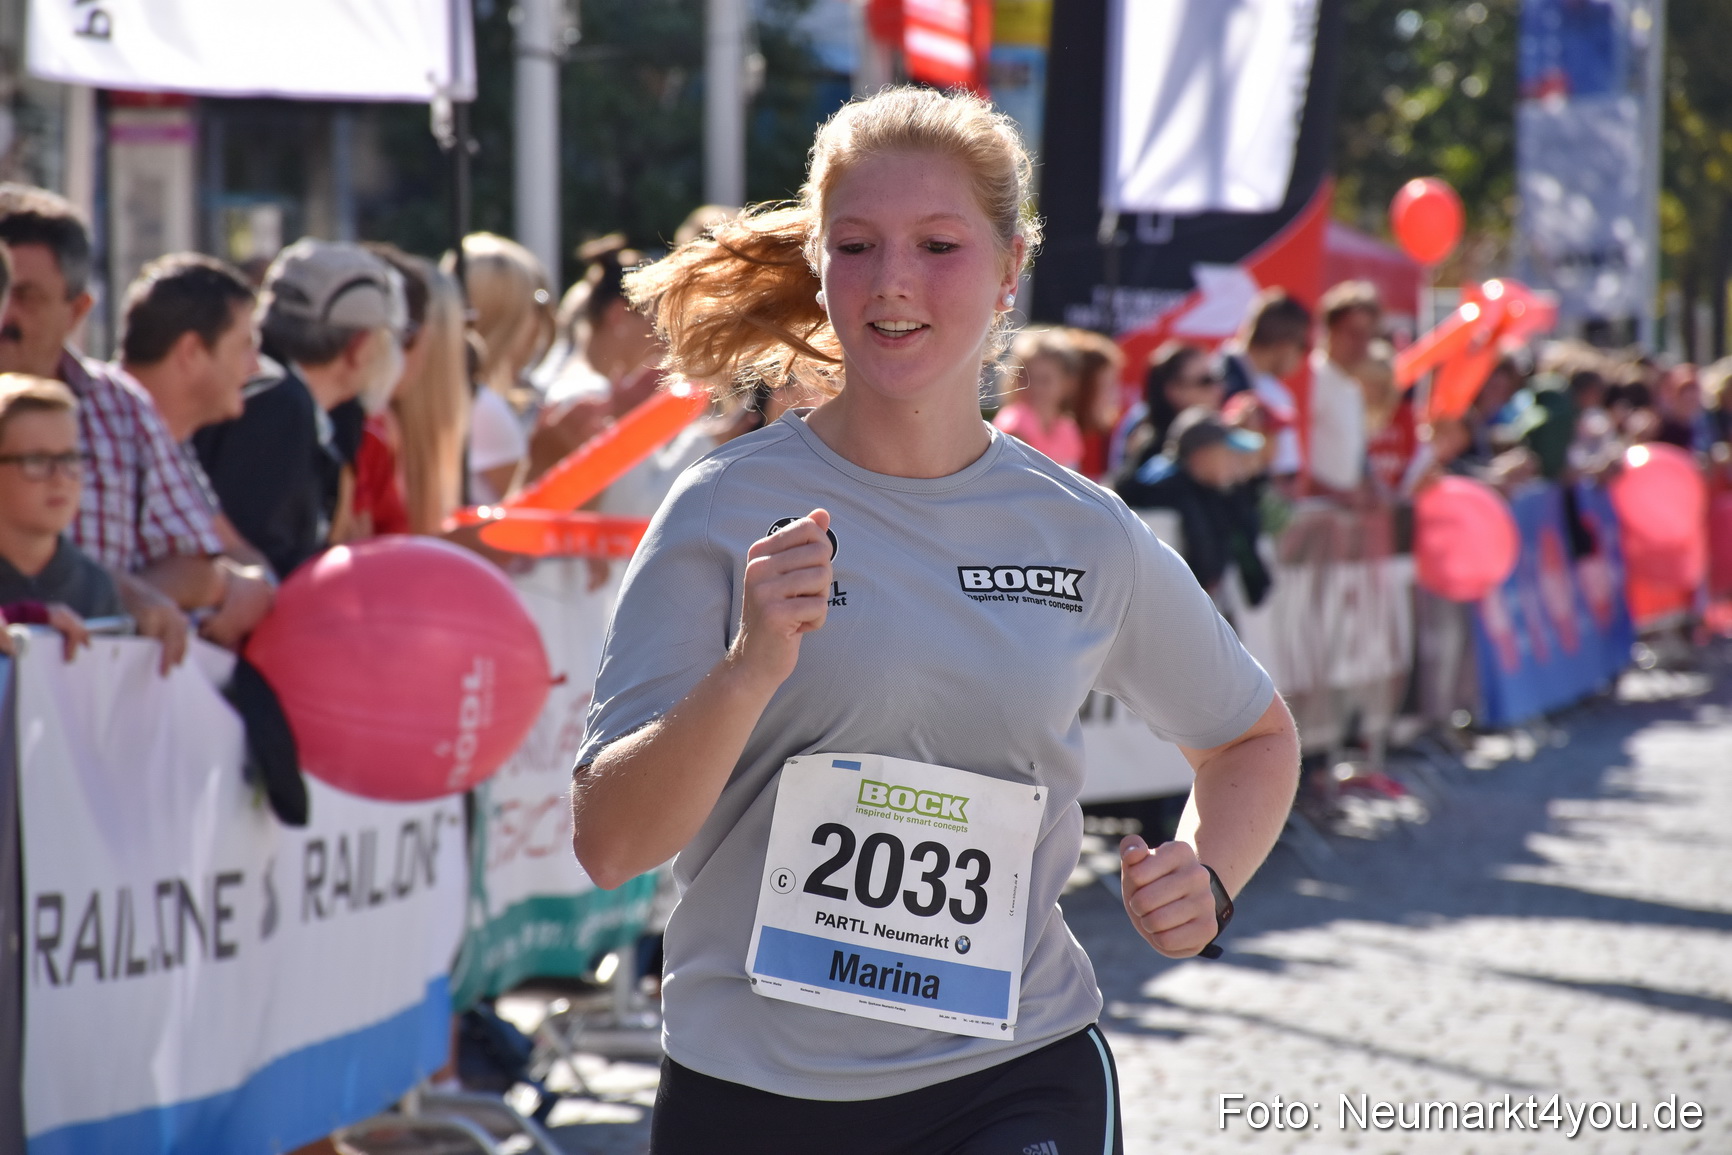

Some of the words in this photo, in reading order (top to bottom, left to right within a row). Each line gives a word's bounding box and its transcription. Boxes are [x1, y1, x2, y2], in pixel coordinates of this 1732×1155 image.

[957, 566, 1086, 601] BOCK
[1007, 594, 1019, 603] by
[1022, 596, 1047, 606] smart
[1049, 600, 1083, 613] concepts
[857, 778, 970, 823] BOCK
[855, 805, 891, 819] inspired
[893, 812, 904, 823] by
[906, 816, 931, 827] smart
[933, 820, 968, 833] concepts
[777, 874, 788, 888] C
[803, 822, 991, 925] 2033
[815, 911, 869, 935] PARTL
[873, 923, 950, 949] Neumarkt
[828, 949, 941, 1001] Marina
